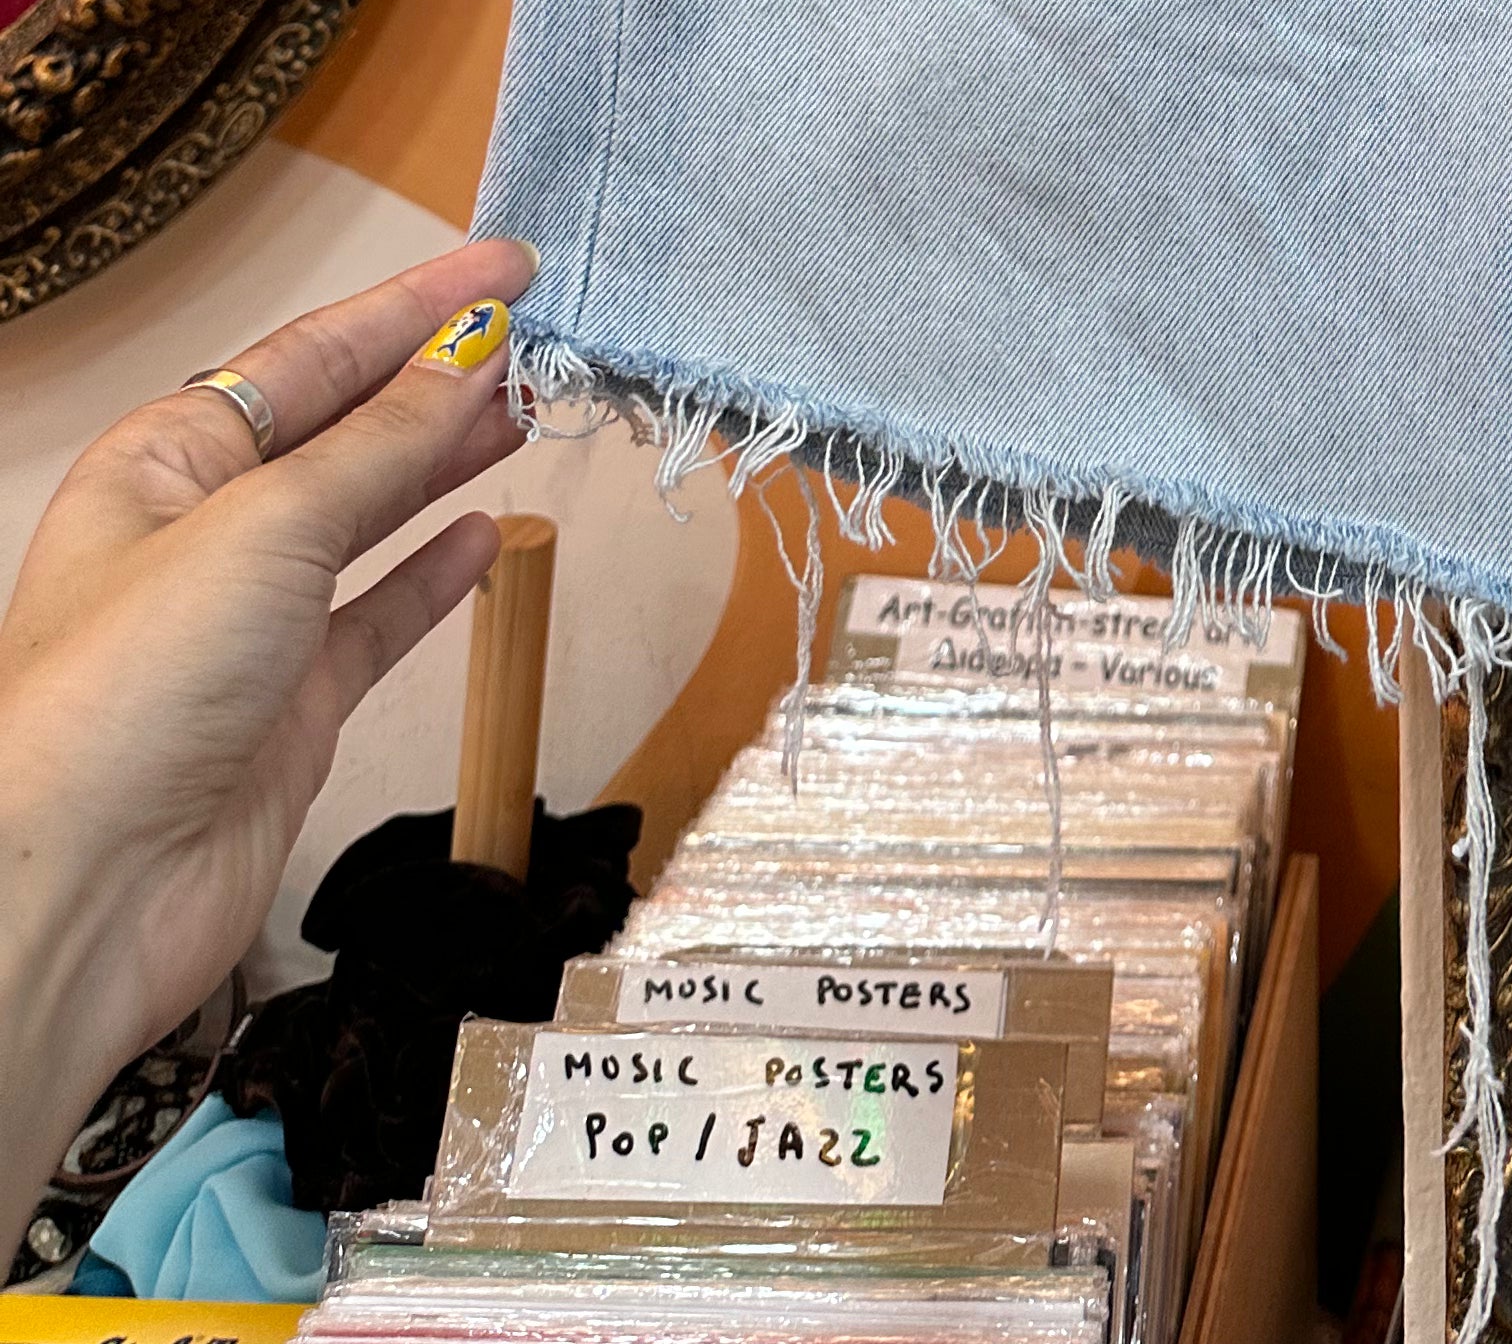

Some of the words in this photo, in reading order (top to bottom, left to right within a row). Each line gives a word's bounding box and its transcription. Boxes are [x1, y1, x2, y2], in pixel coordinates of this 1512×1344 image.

[1101, 650, 1219, 692] Various
[817, 975, 971, 1014] POSTERS
[764, 1056, 945, 1097] POSTERS
[736, 1114, 881, 1168] JAZZ
